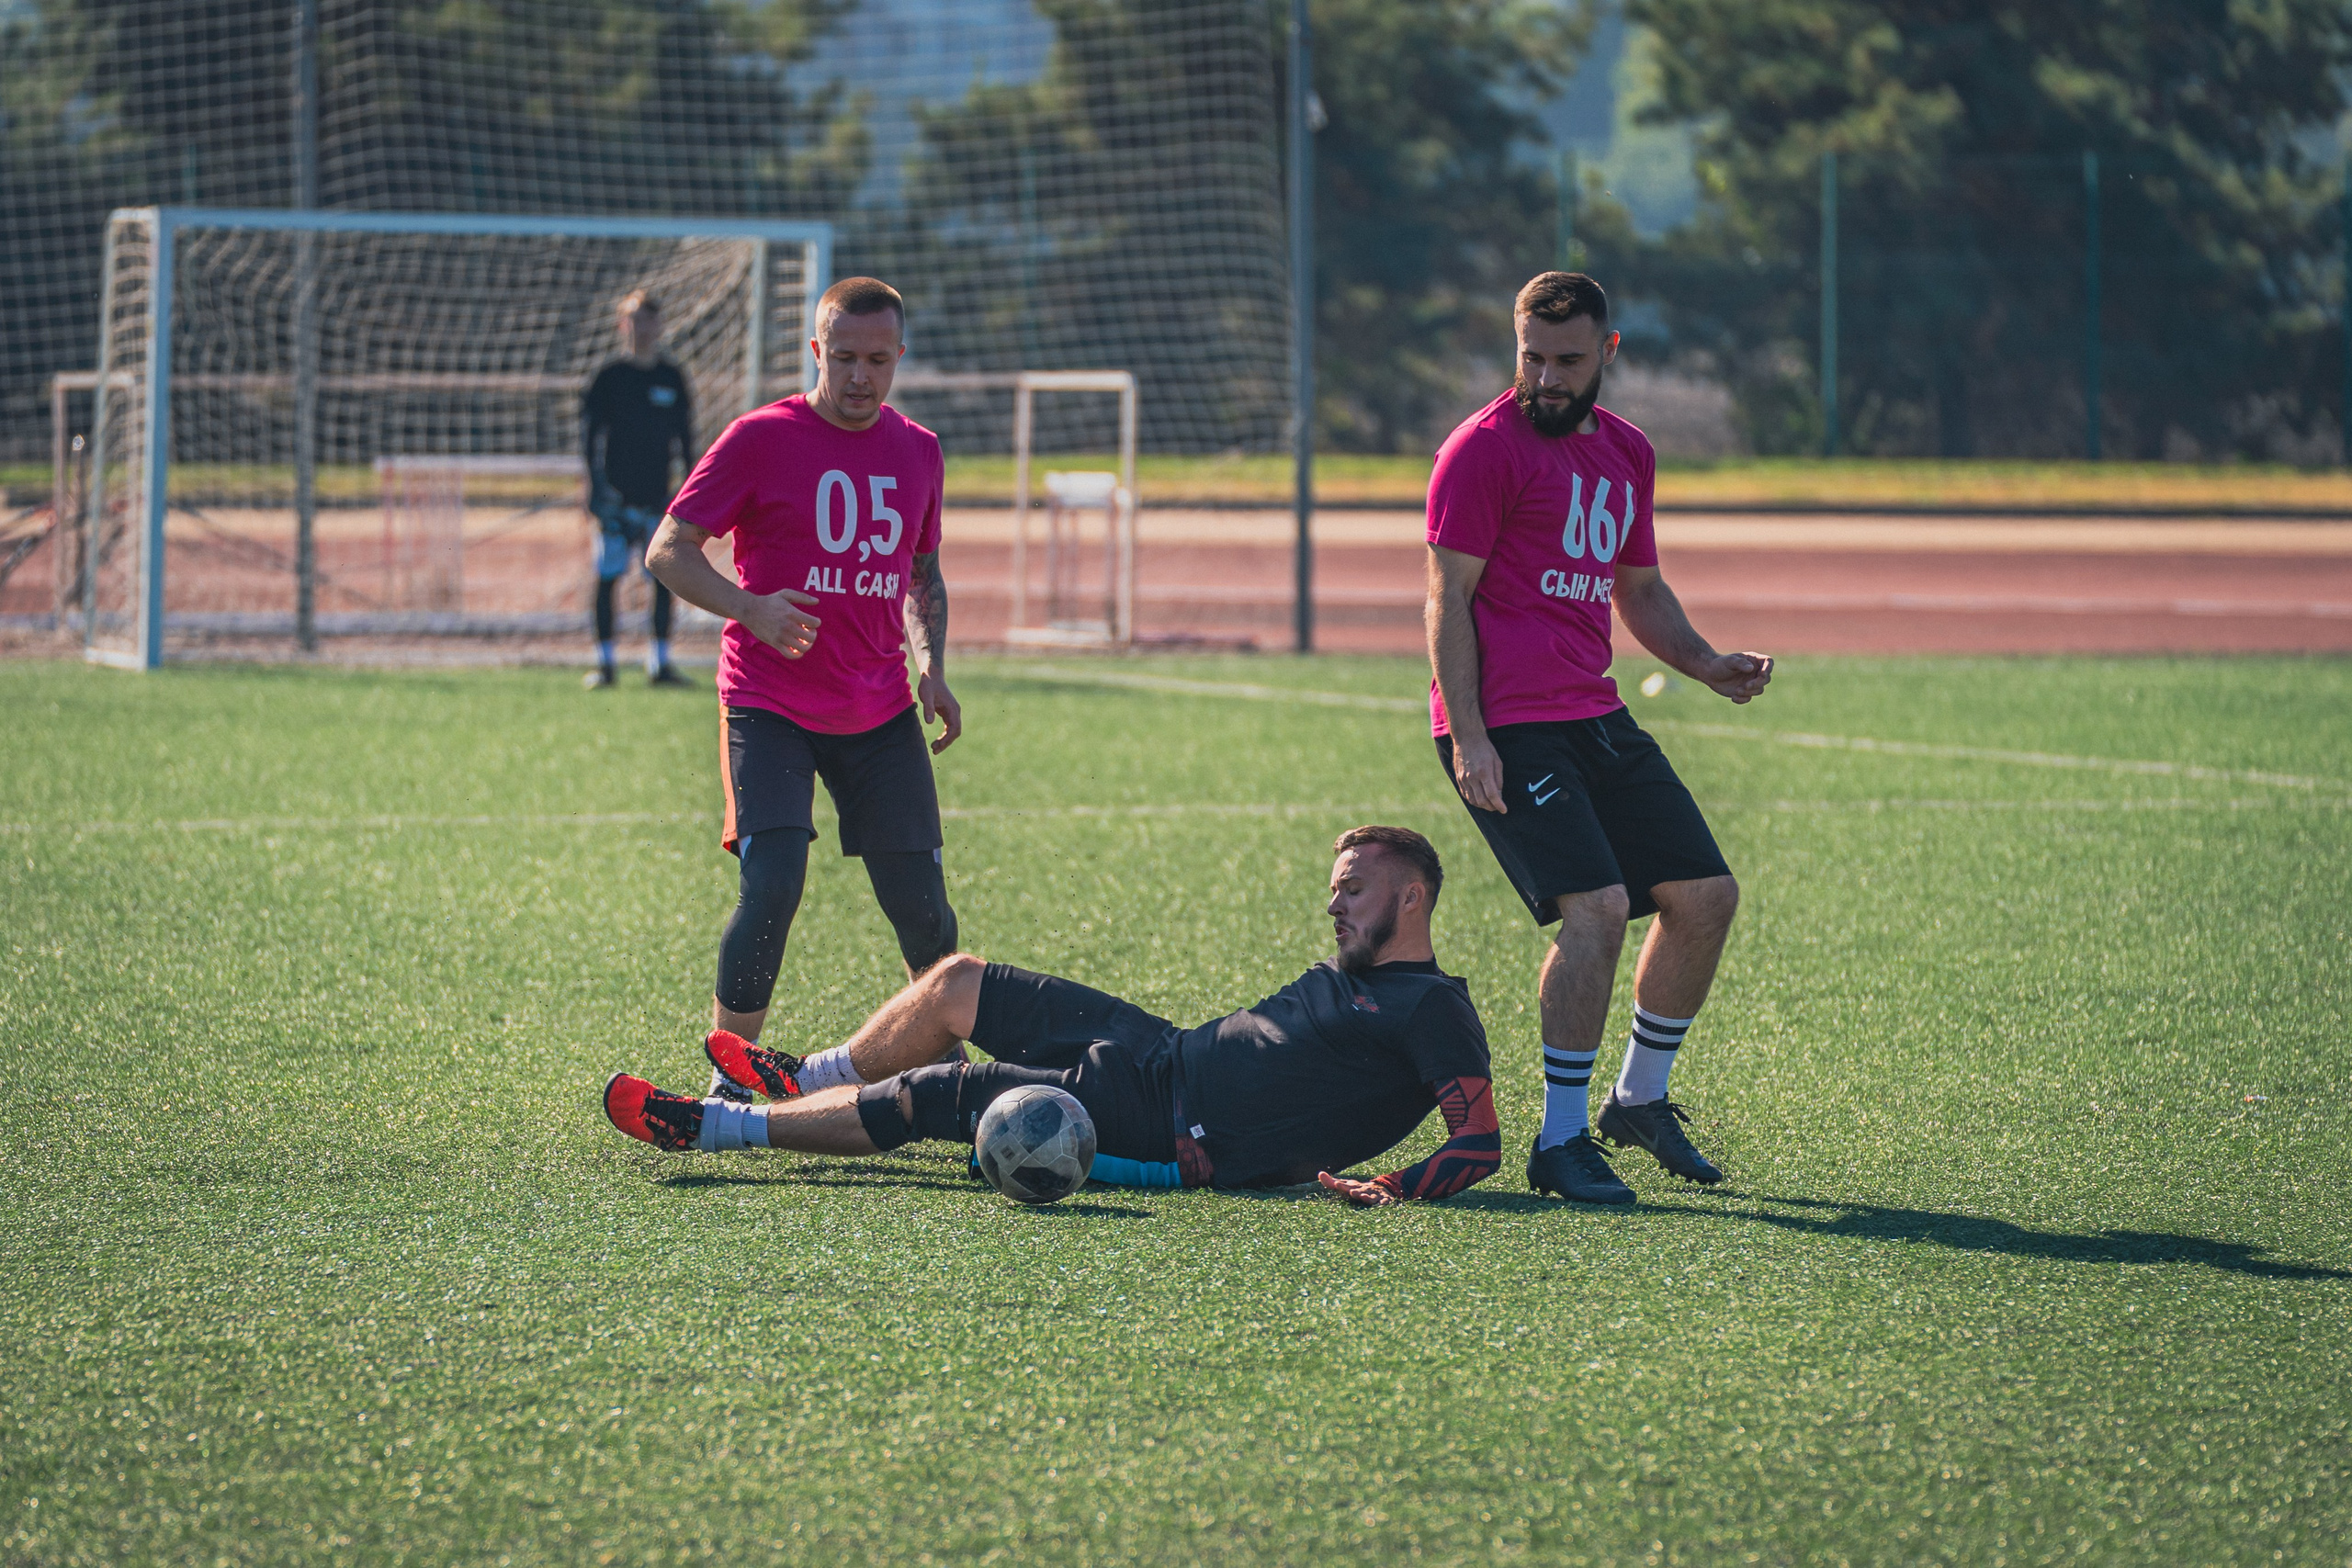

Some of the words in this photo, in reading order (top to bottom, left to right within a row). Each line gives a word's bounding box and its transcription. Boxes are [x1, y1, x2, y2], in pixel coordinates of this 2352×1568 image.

[816, 469, 903, 563] 0,5
[803, 566, 846, 594] ALL
[1541, 569, 1590, 601] СЫН
